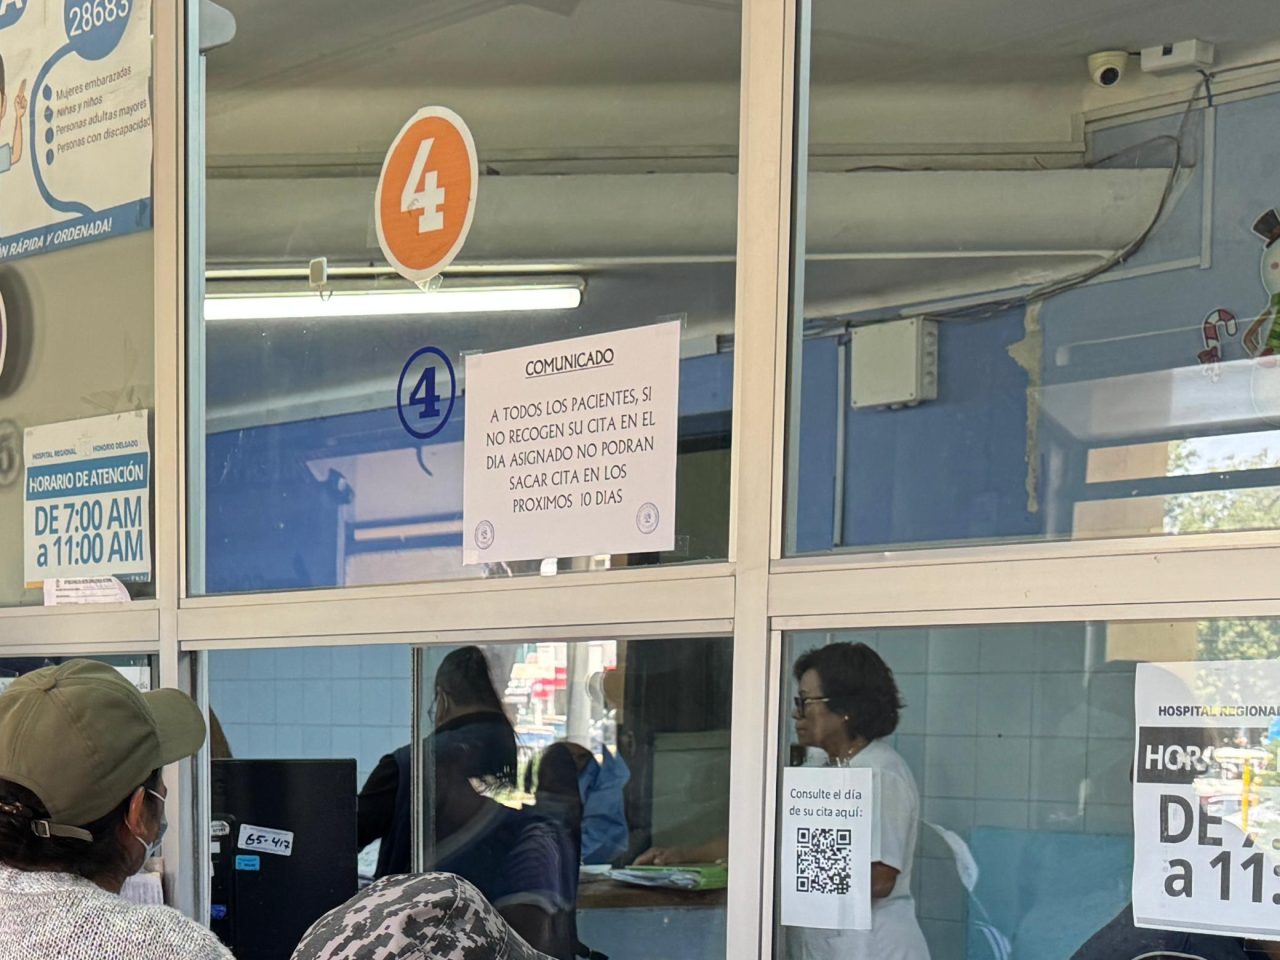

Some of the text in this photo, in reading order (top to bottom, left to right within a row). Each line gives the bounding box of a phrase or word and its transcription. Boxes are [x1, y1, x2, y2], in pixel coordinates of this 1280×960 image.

[56, 66, 131, 100] Mujeres embarazadas
[56, 99, 147, 136] Personas adultas mayores
[57, 137, 85, 154] Personas
[86, 132, 101, 145] con
[401, 138, 445, 233] 4
[9, 238, 44, 256] RÁPIDA
[45, 233, 54, 246] Y
[54, 218, 112, 244] ORDENADA!
[525, 348, 614, 377] COMUNICADO
[409, 367, 440, 418] 4
[490, 386, 652, 423] A TODOS LOS PACIENTES, SI
[486, 411, 655, 447] NO RECOGEN SU CITA EN EL
[32, 450, 53, 460] HOSPITAL
[54, 448, 77, 457] REGIONAL
[115, 439, 138, 449] DELGADO
[486, 436, 654, 470] DIA ASIGNADO NO PODRAN
[29, 460, 144, 493] HORARIO DE ATENCIÓN
[509, 464, 627, 490] SACAR CITA EN LOS
[35, 496, 142, 536] DE 7:00 AM
[513, 494, 573, 513] PROXIMOS
[596, 489, 623, 505] DIAS
[37, 529, 144, 567] a 11:00 AM
[1159, 706, 1216, 717] HOSPITAL
[790, 788, 862, 800] Consulte el día
[789, 805, 863, 819] de su cita aquí:
[1159, 794, 1223, 846] DE
[1164, 858, 1193, 898] a
